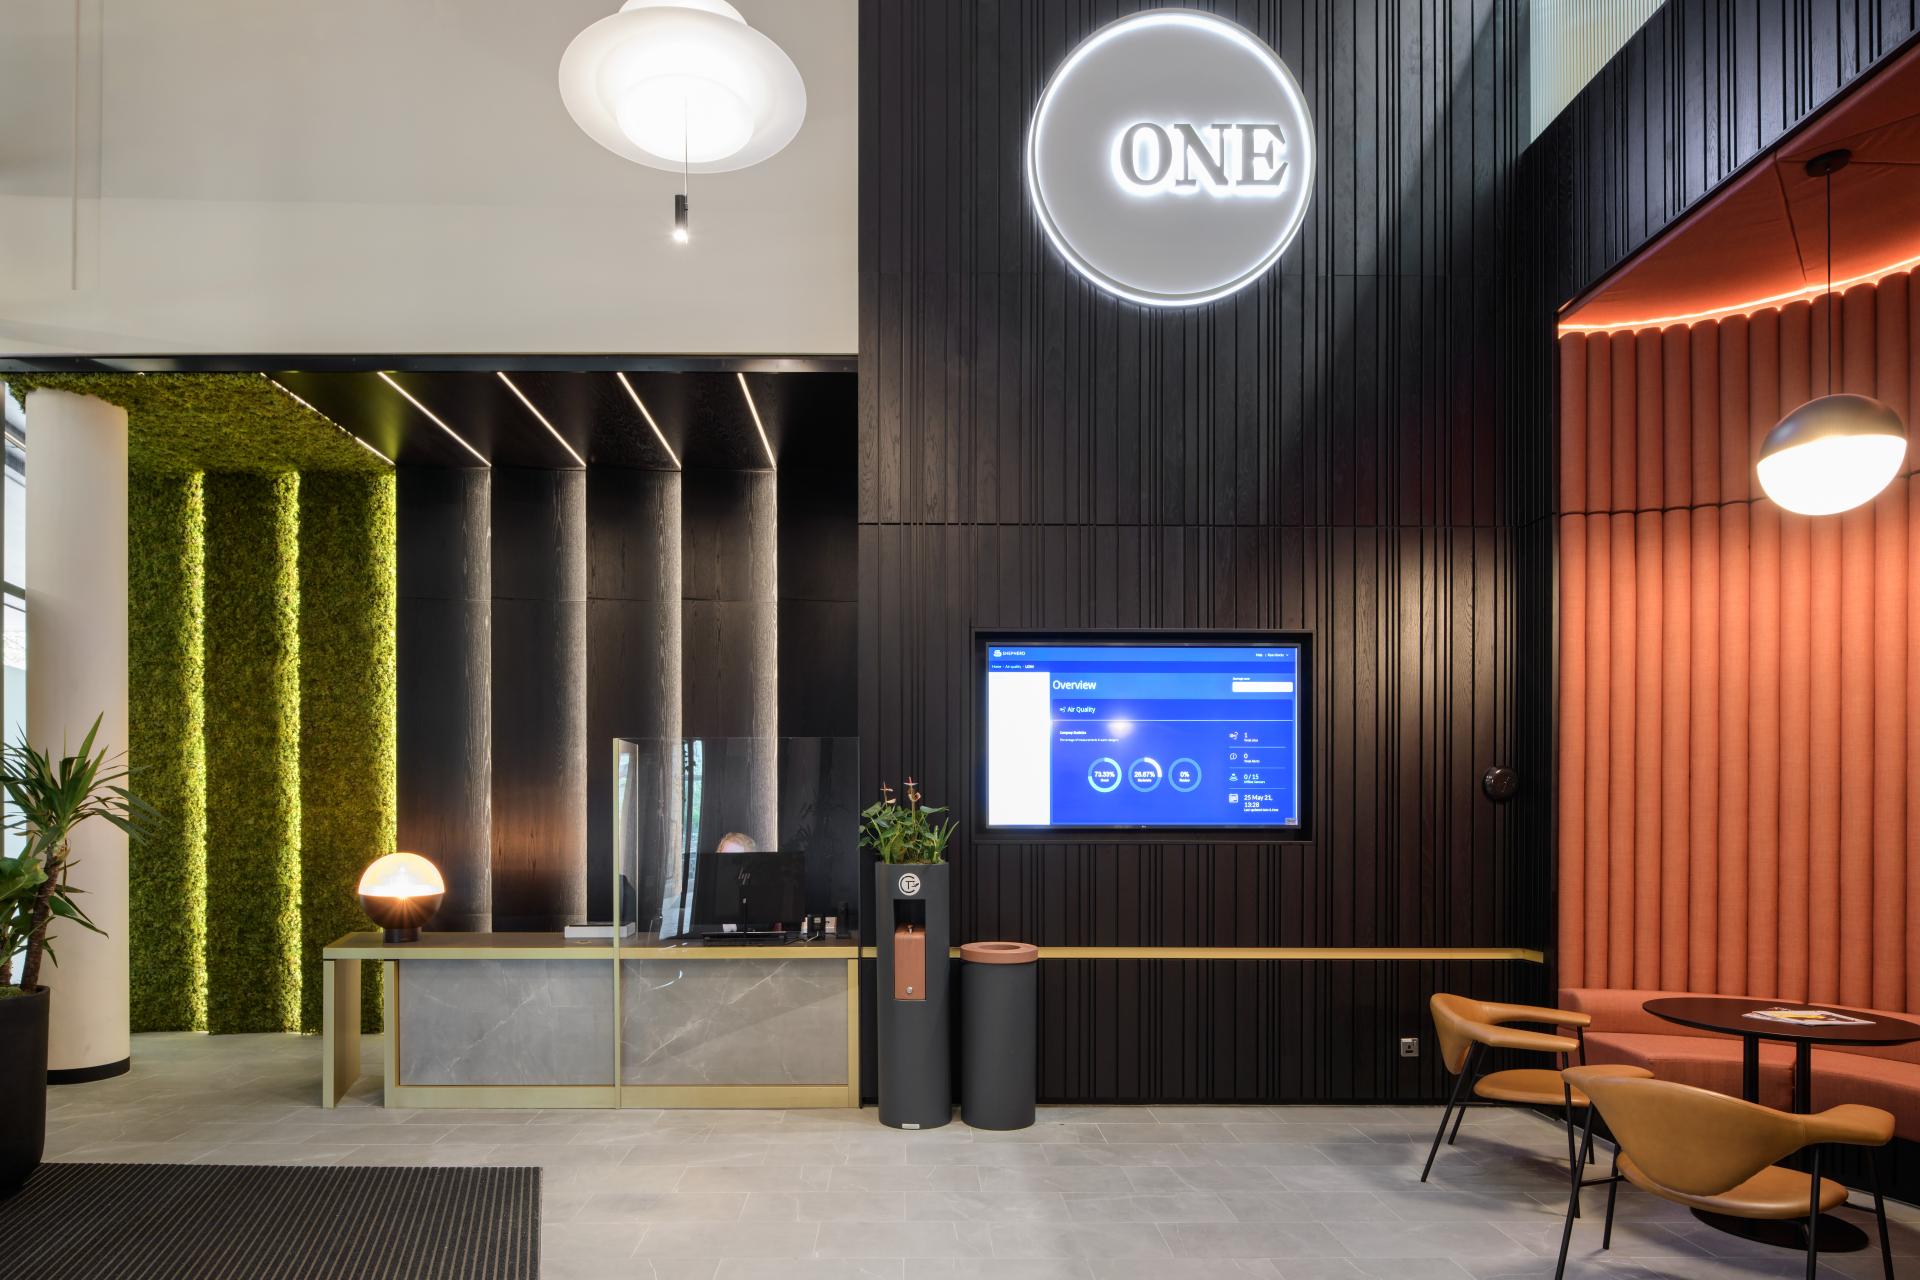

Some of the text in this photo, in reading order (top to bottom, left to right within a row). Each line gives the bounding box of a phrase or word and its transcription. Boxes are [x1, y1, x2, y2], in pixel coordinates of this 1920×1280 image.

[1120, 122, 1289, 187] ONE
[1052, 679, 1097, 690] Overview
[1076, 706, 1096, 714] Quality
[1251, 794, 1263, 802] May
